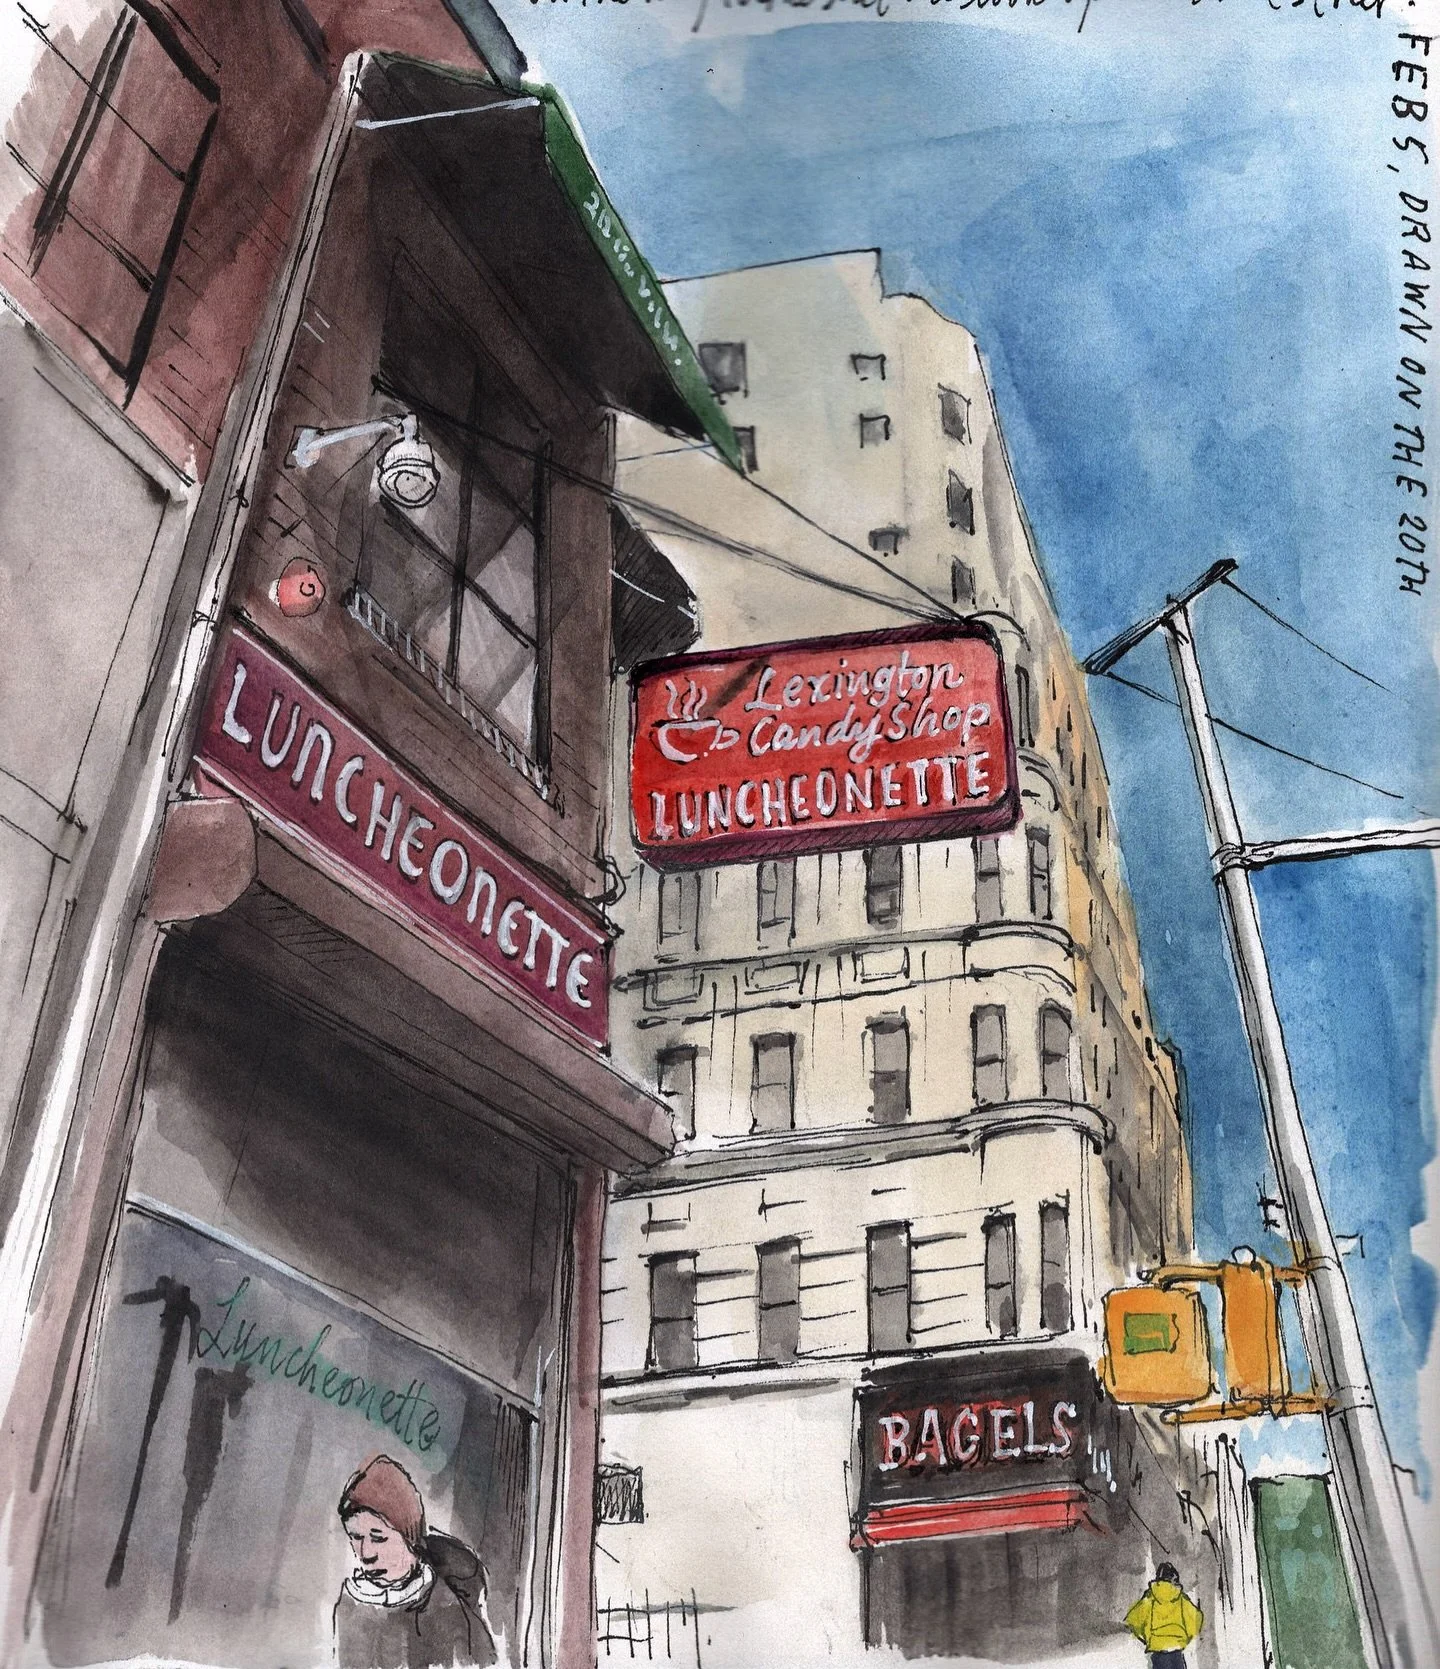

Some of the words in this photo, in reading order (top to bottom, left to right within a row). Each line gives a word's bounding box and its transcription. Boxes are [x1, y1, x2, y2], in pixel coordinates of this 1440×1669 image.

[1392, 32, 1432, 123] FEB
[1399, 190, 1432, 344] DRAWN
[1396, 356, 1427, 410] ON
[1392, 423, 1428, 498] THE
[1395, 512, 1430, 597] 20TH
[745, 650, 964, 712] Lexington
[750, 704, 883, 764] Candy
[889, 698, 991, 746] Shop
[221, 663, 594, 1009] LUNCHEONETTE
[651, 751, 991, 840] LUNCHEONETTE
[196, 1275, 441, 1451] Luncheonette
[878, 1400, 1077, 1472] BAGELS
